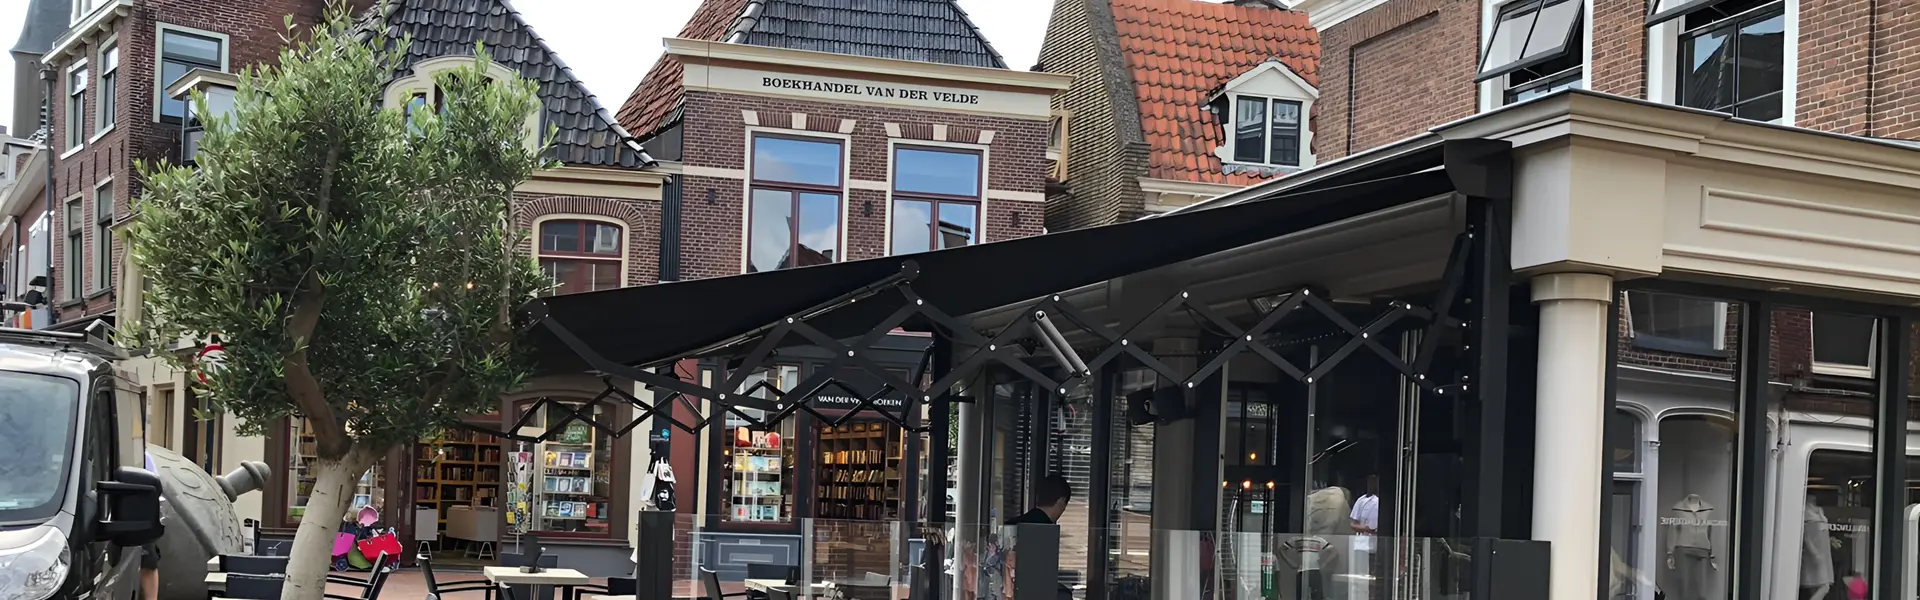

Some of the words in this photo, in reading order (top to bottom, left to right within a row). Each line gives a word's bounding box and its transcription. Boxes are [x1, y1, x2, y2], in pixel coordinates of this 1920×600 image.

[762, 77, 862, 95] BOEKHANDEL
[865, 86, 895, 97] VAN
[899, 88, 928, 100] DER
[933, 91, 979, 104] VELDE
[817, 395, 834, 403] VAN
[835, 396, 849, 404] DER
